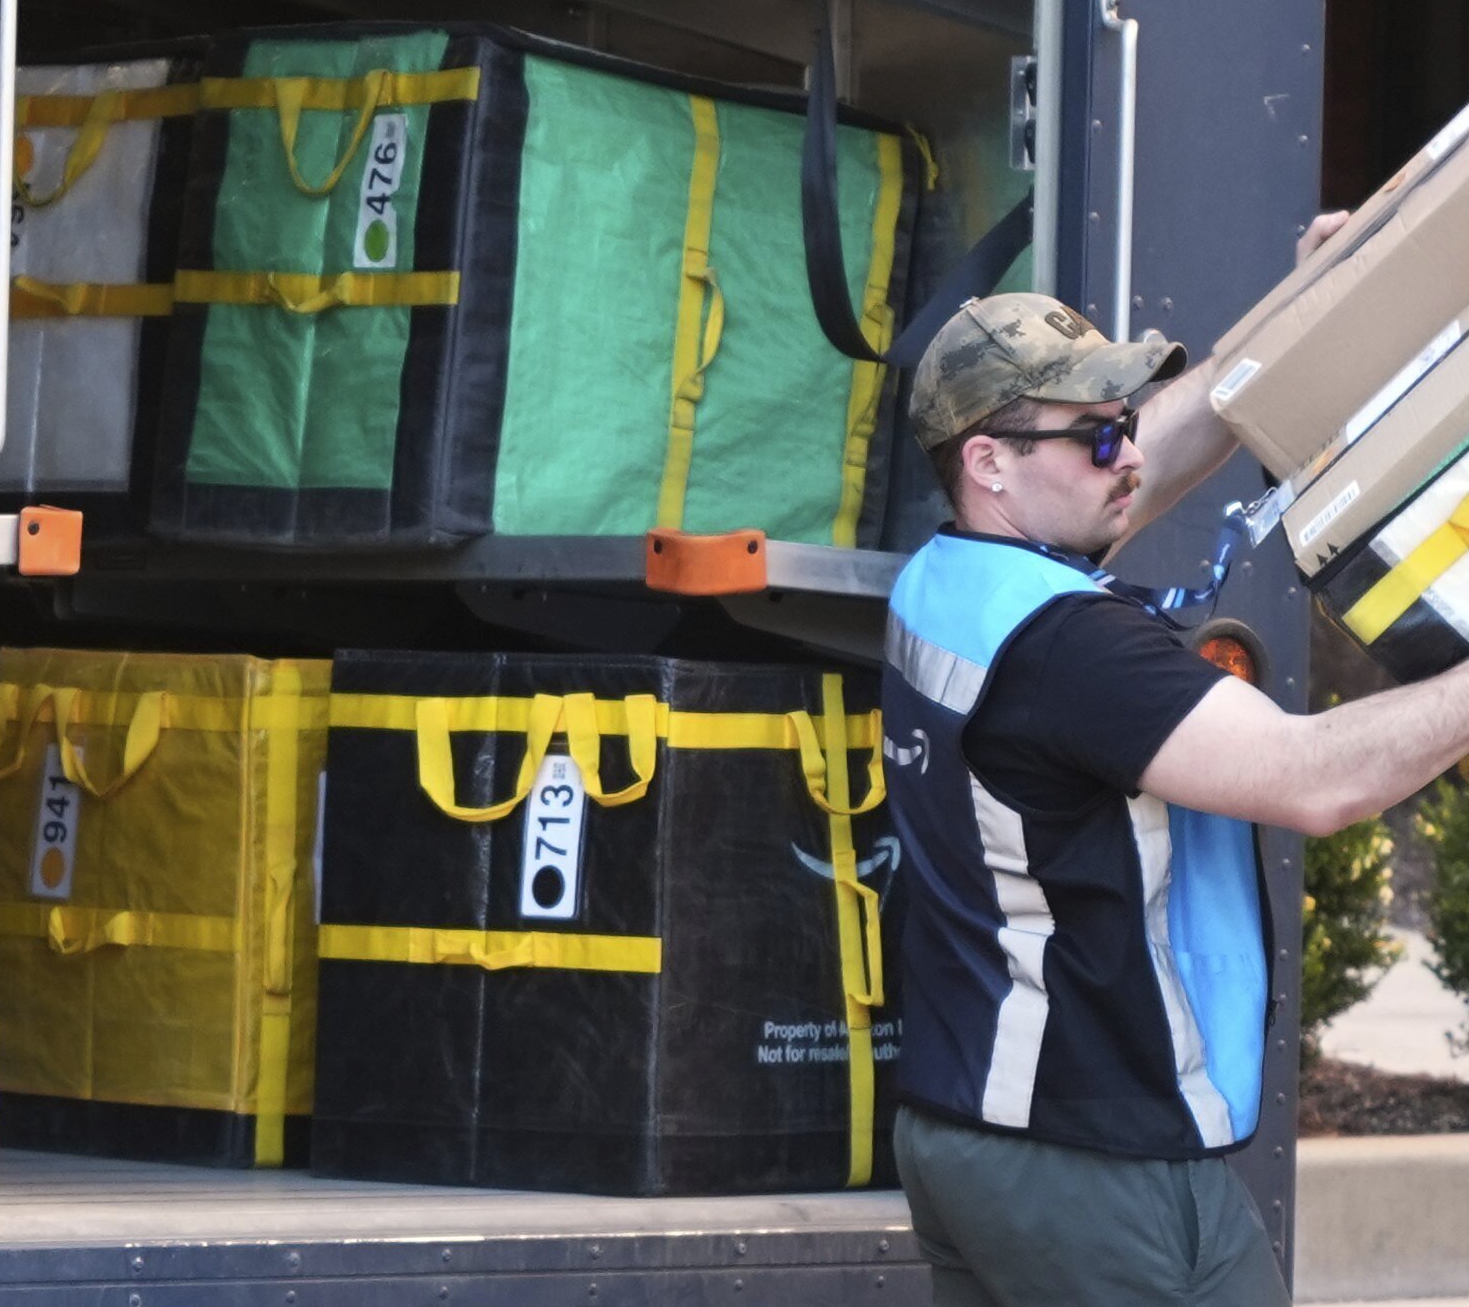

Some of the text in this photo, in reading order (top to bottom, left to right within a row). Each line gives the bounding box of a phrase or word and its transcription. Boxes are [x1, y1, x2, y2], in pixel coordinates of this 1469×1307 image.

[365, 141, 398, 216] 476
[43, 774, 71, 844] 941
[534, 783, 574, 861] 713
[757, 1044, 783, 1063] Not
[785, 1044, 806, 1062] for
[763, 1020, 822, 1042] Property
[824, 1020, 837, 1036] of
